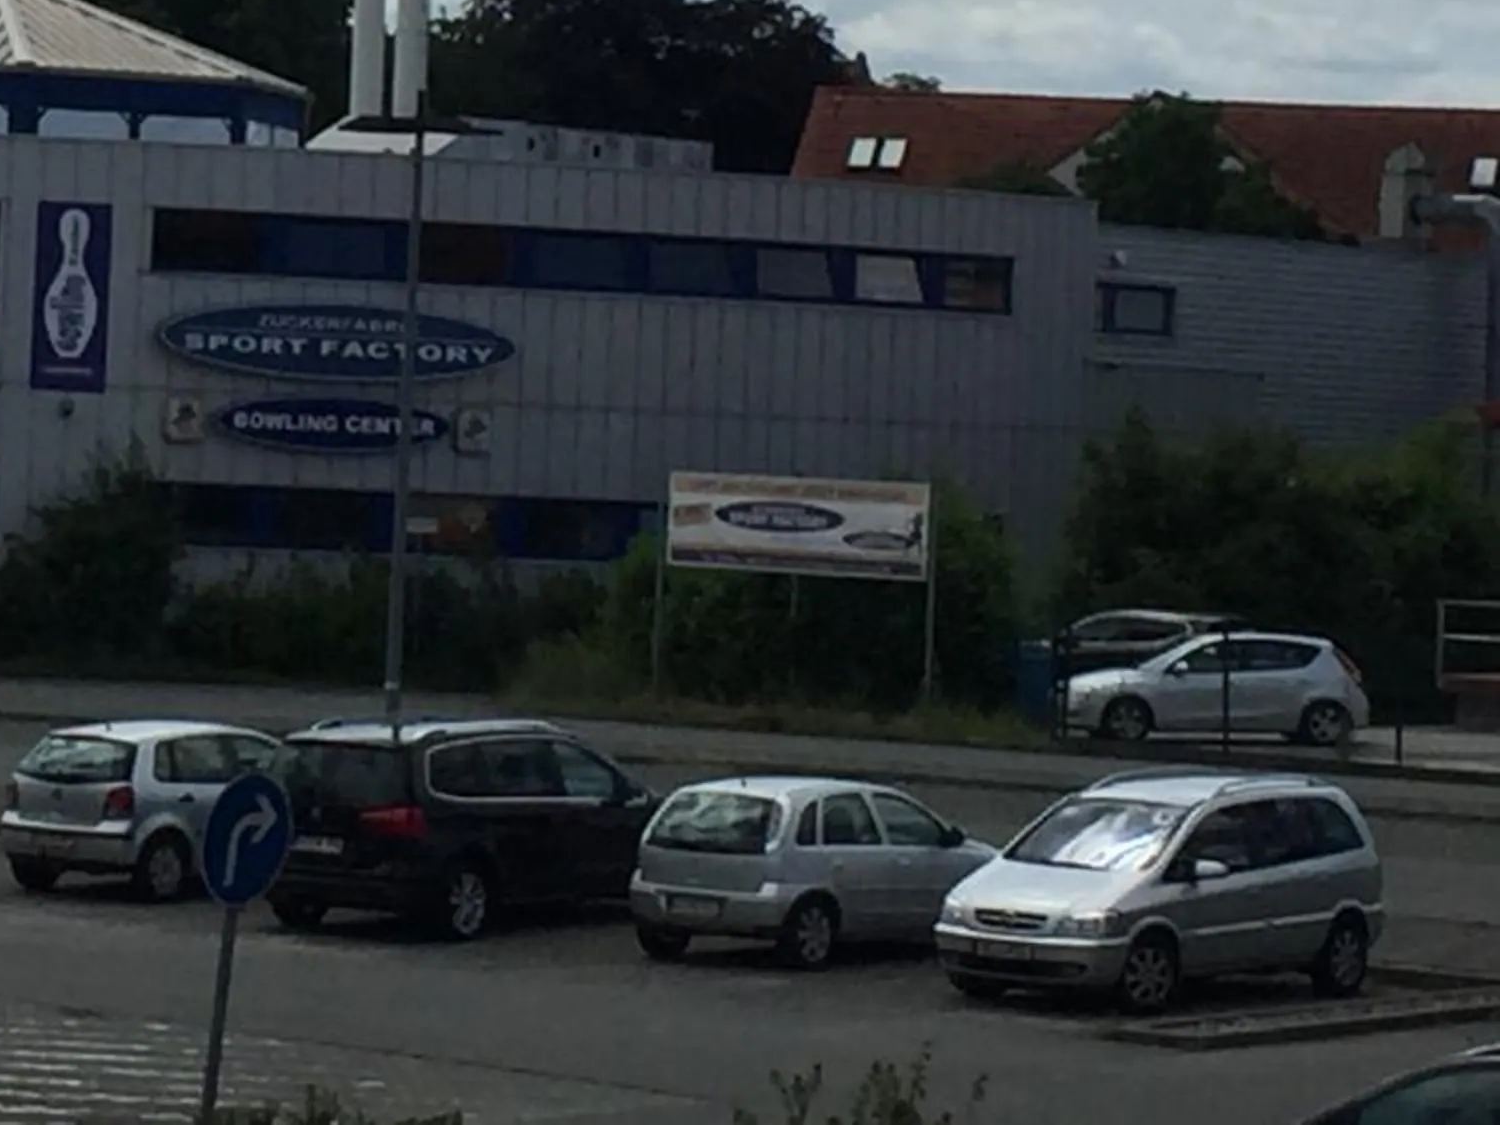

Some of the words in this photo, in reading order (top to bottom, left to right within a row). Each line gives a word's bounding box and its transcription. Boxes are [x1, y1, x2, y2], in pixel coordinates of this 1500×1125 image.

[184, 332, 309, 355] SPORT
[319, 338, 494, 364] FACTORY
[232, 410, 339, 433] BOWLING
[345, 414, 436, 436] CENTR
